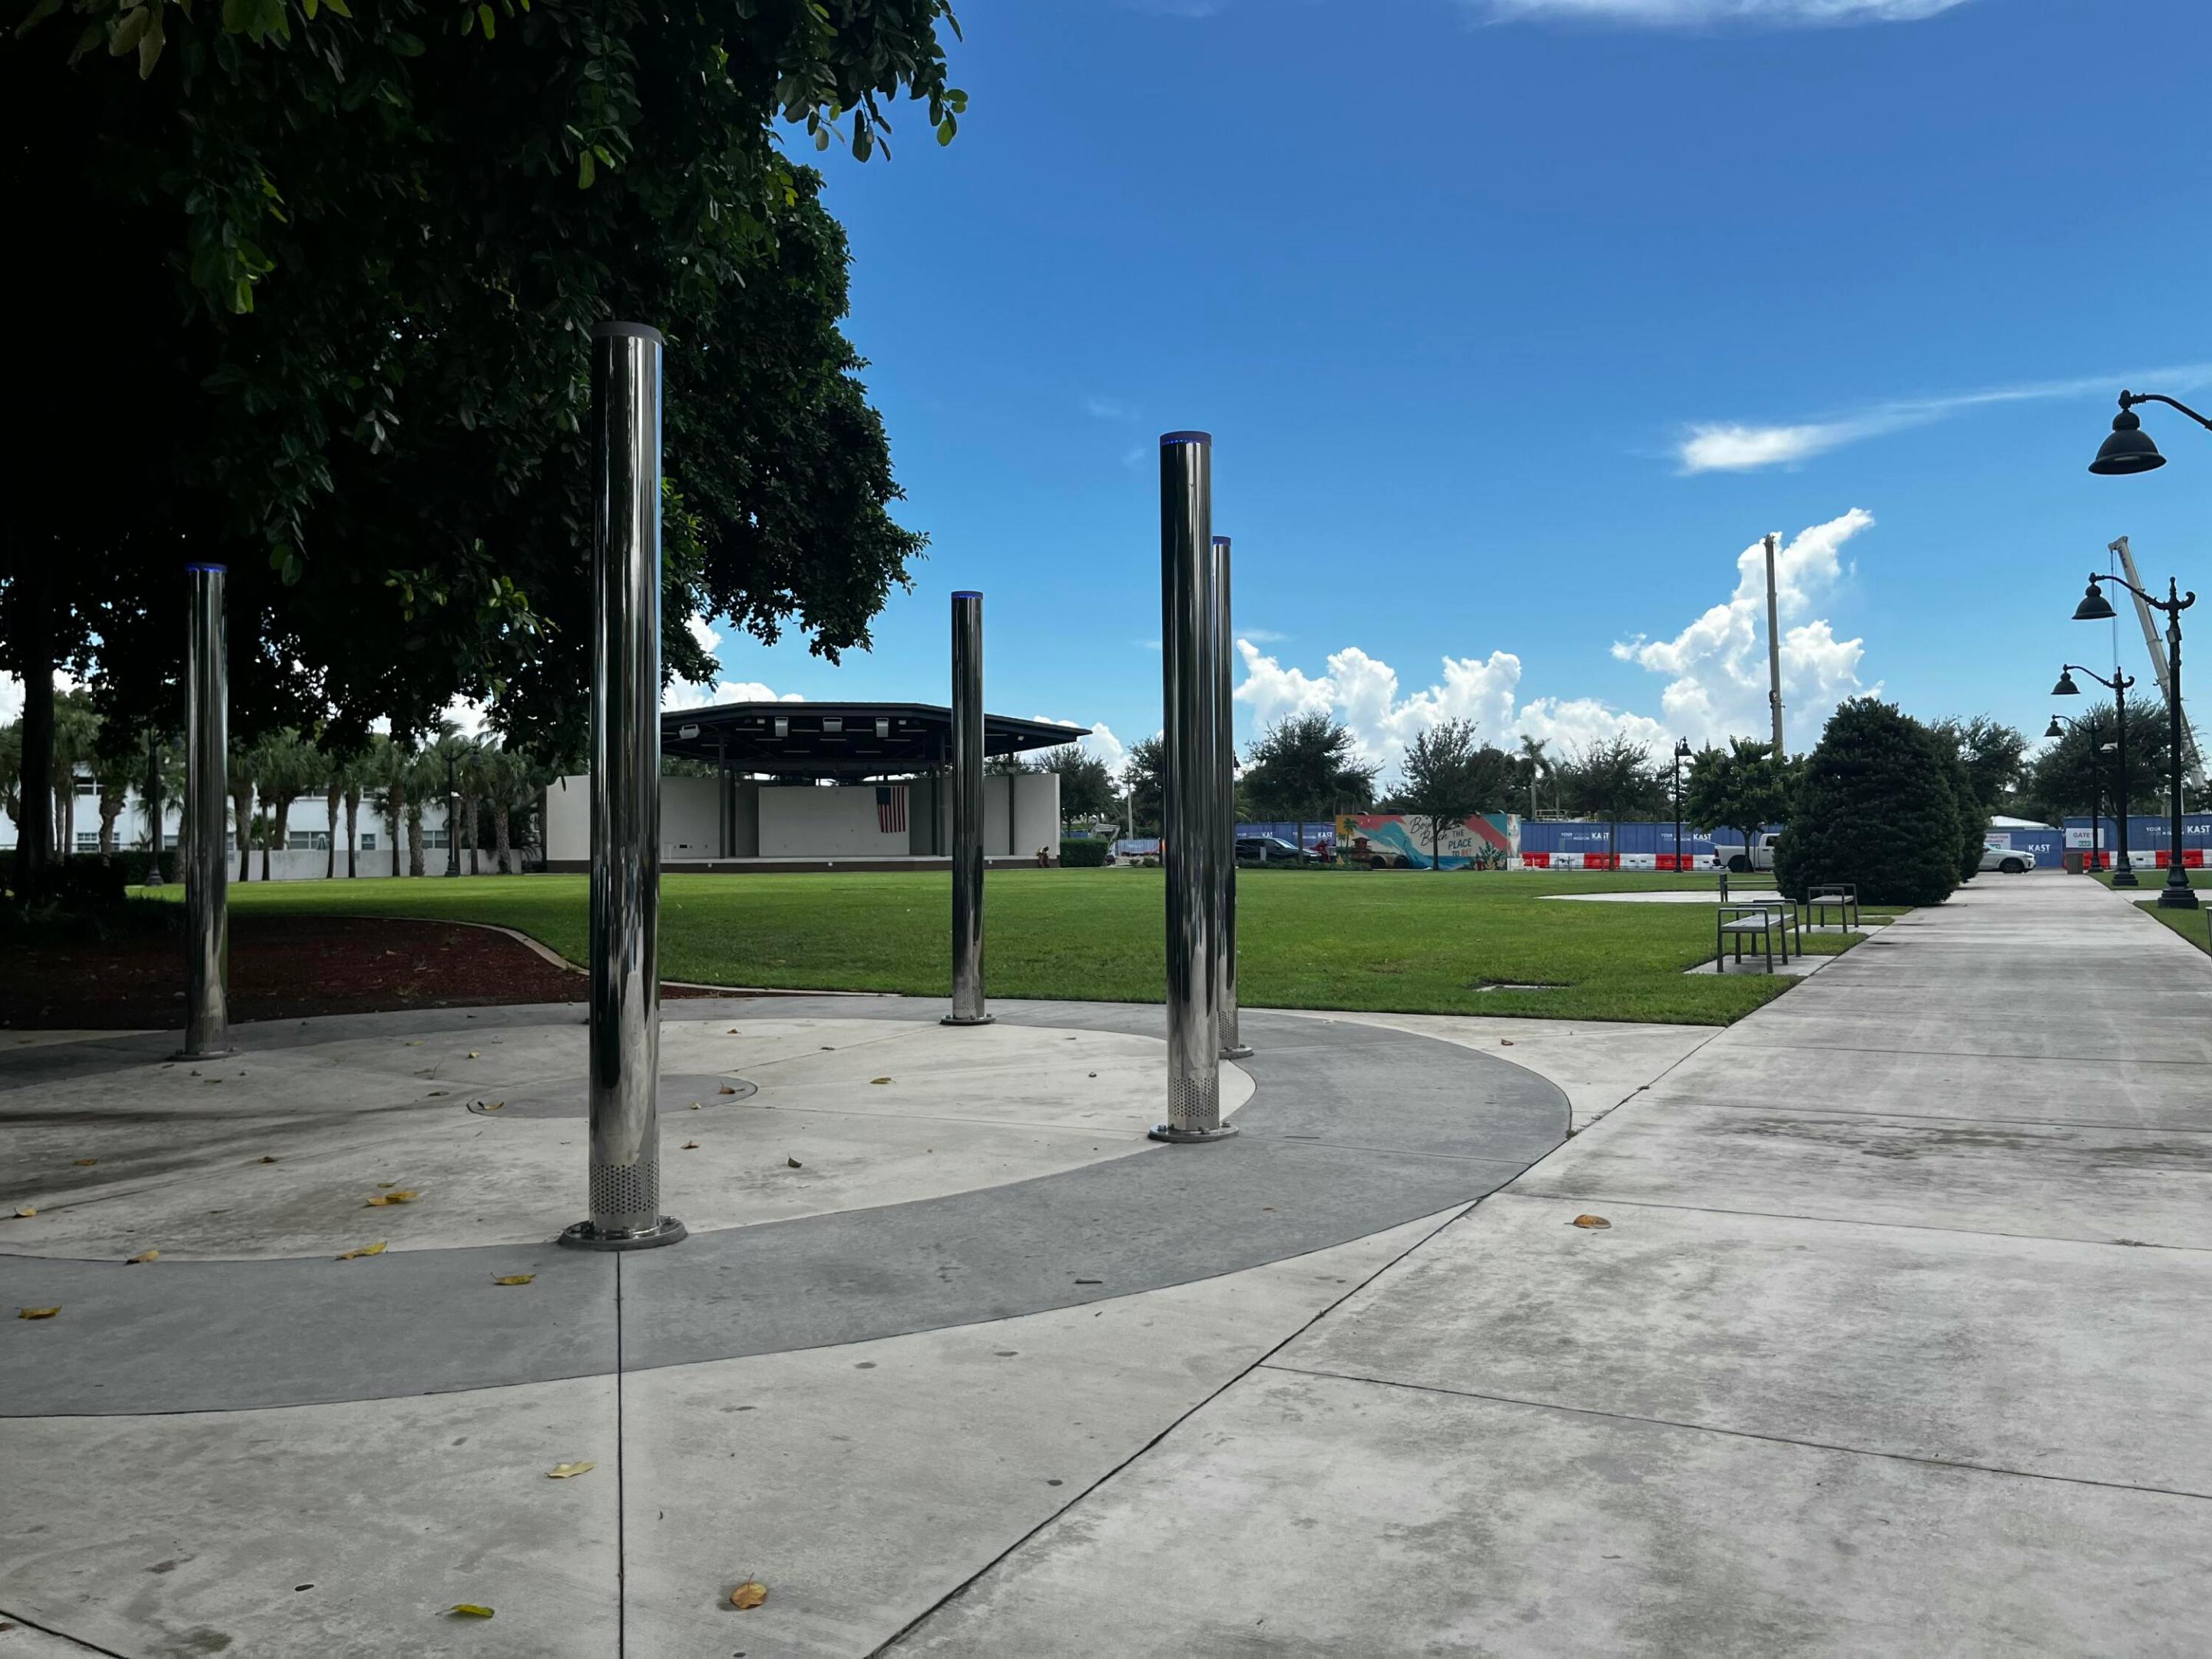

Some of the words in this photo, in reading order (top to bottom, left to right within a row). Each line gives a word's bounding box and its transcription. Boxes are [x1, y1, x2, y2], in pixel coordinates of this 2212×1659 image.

[1452, 829, 1465, 837] THE
[2187, 825, 2210, 833] KAST
[1449, 838, 1472, 849] PLACE
[2028, 844, 2051, 853] KAST
